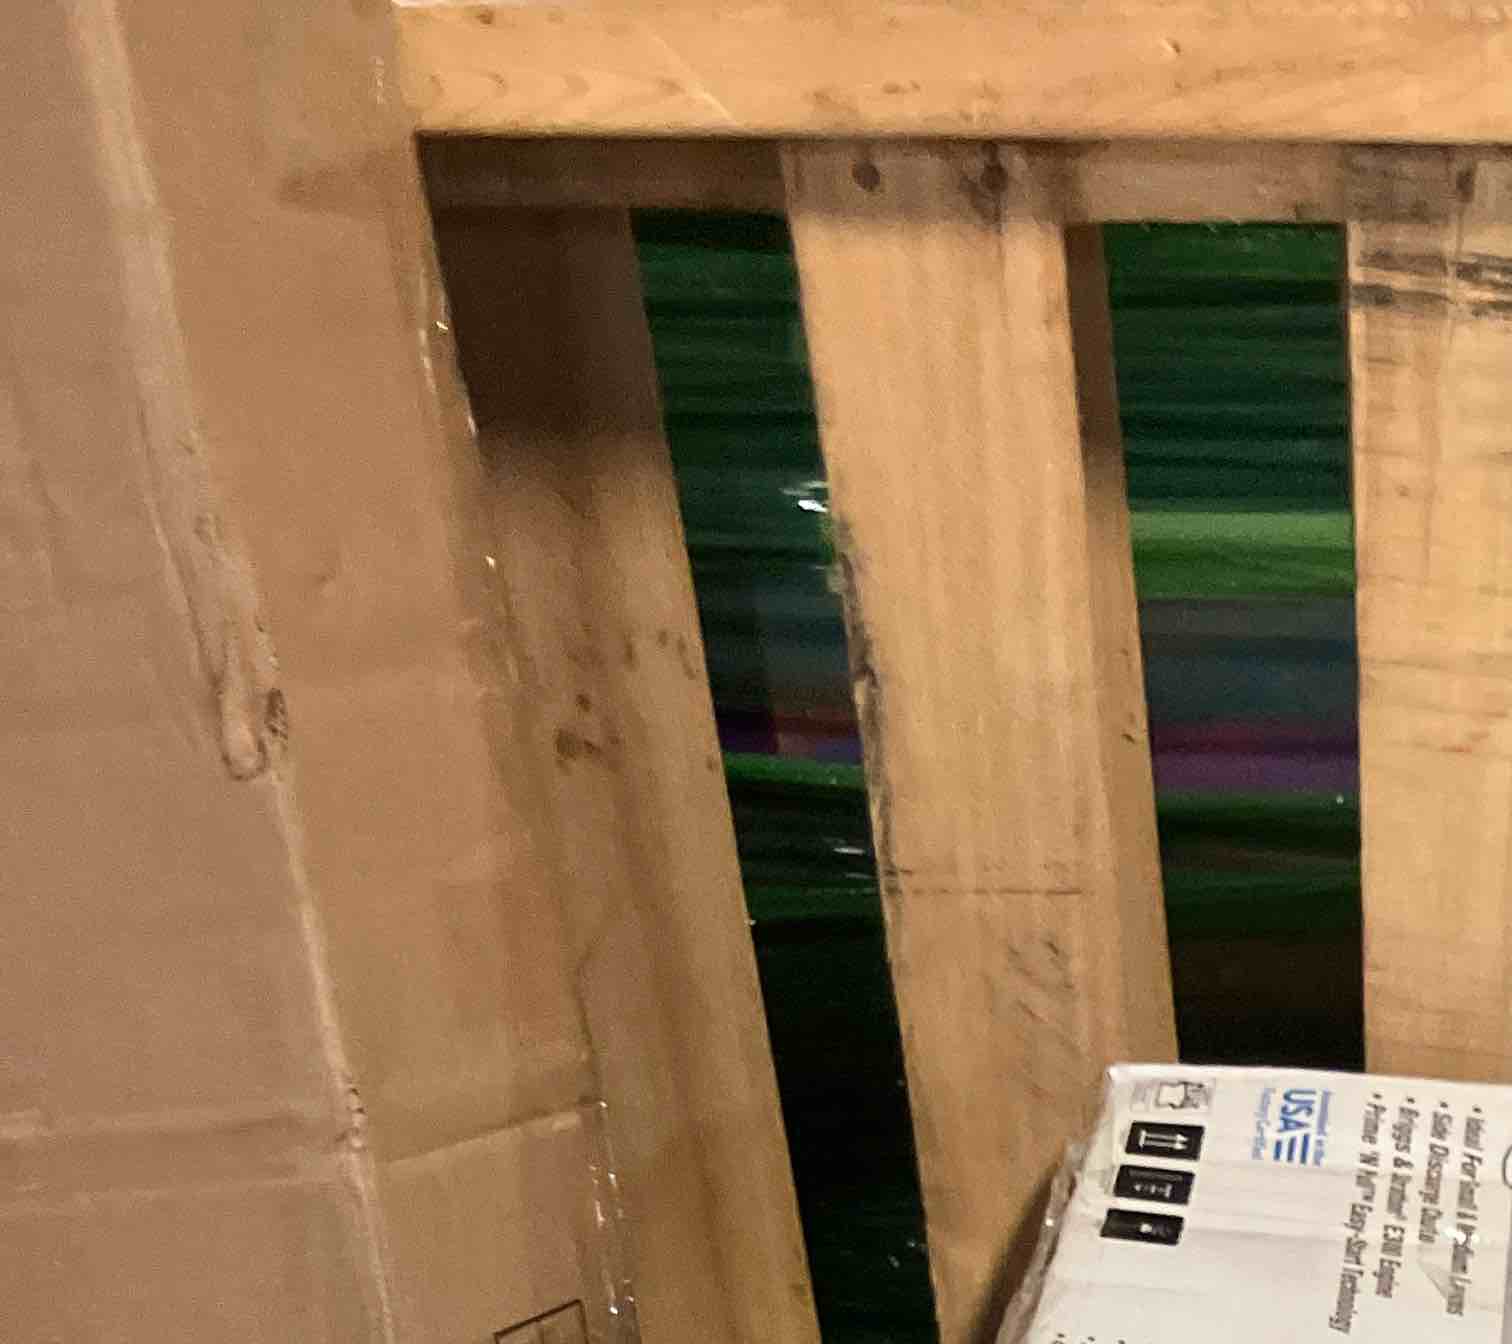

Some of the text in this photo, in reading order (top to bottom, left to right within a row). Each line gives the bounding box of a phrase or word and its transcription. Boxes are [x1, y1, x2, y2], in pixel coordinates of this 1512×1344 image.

[1276, 1088, 1317, 1134] USA
[1361, 1102, 1388, 1146] Prime
[1392, 1105, 1420, 1156] Briggs
[1430, 1111, 1453, 1141] Side
[1461, 1152, 1482, 1179] For
[1328, 1266, 1366, 1336] Technology
[1372, 1258, 1402, 1301] Engine
